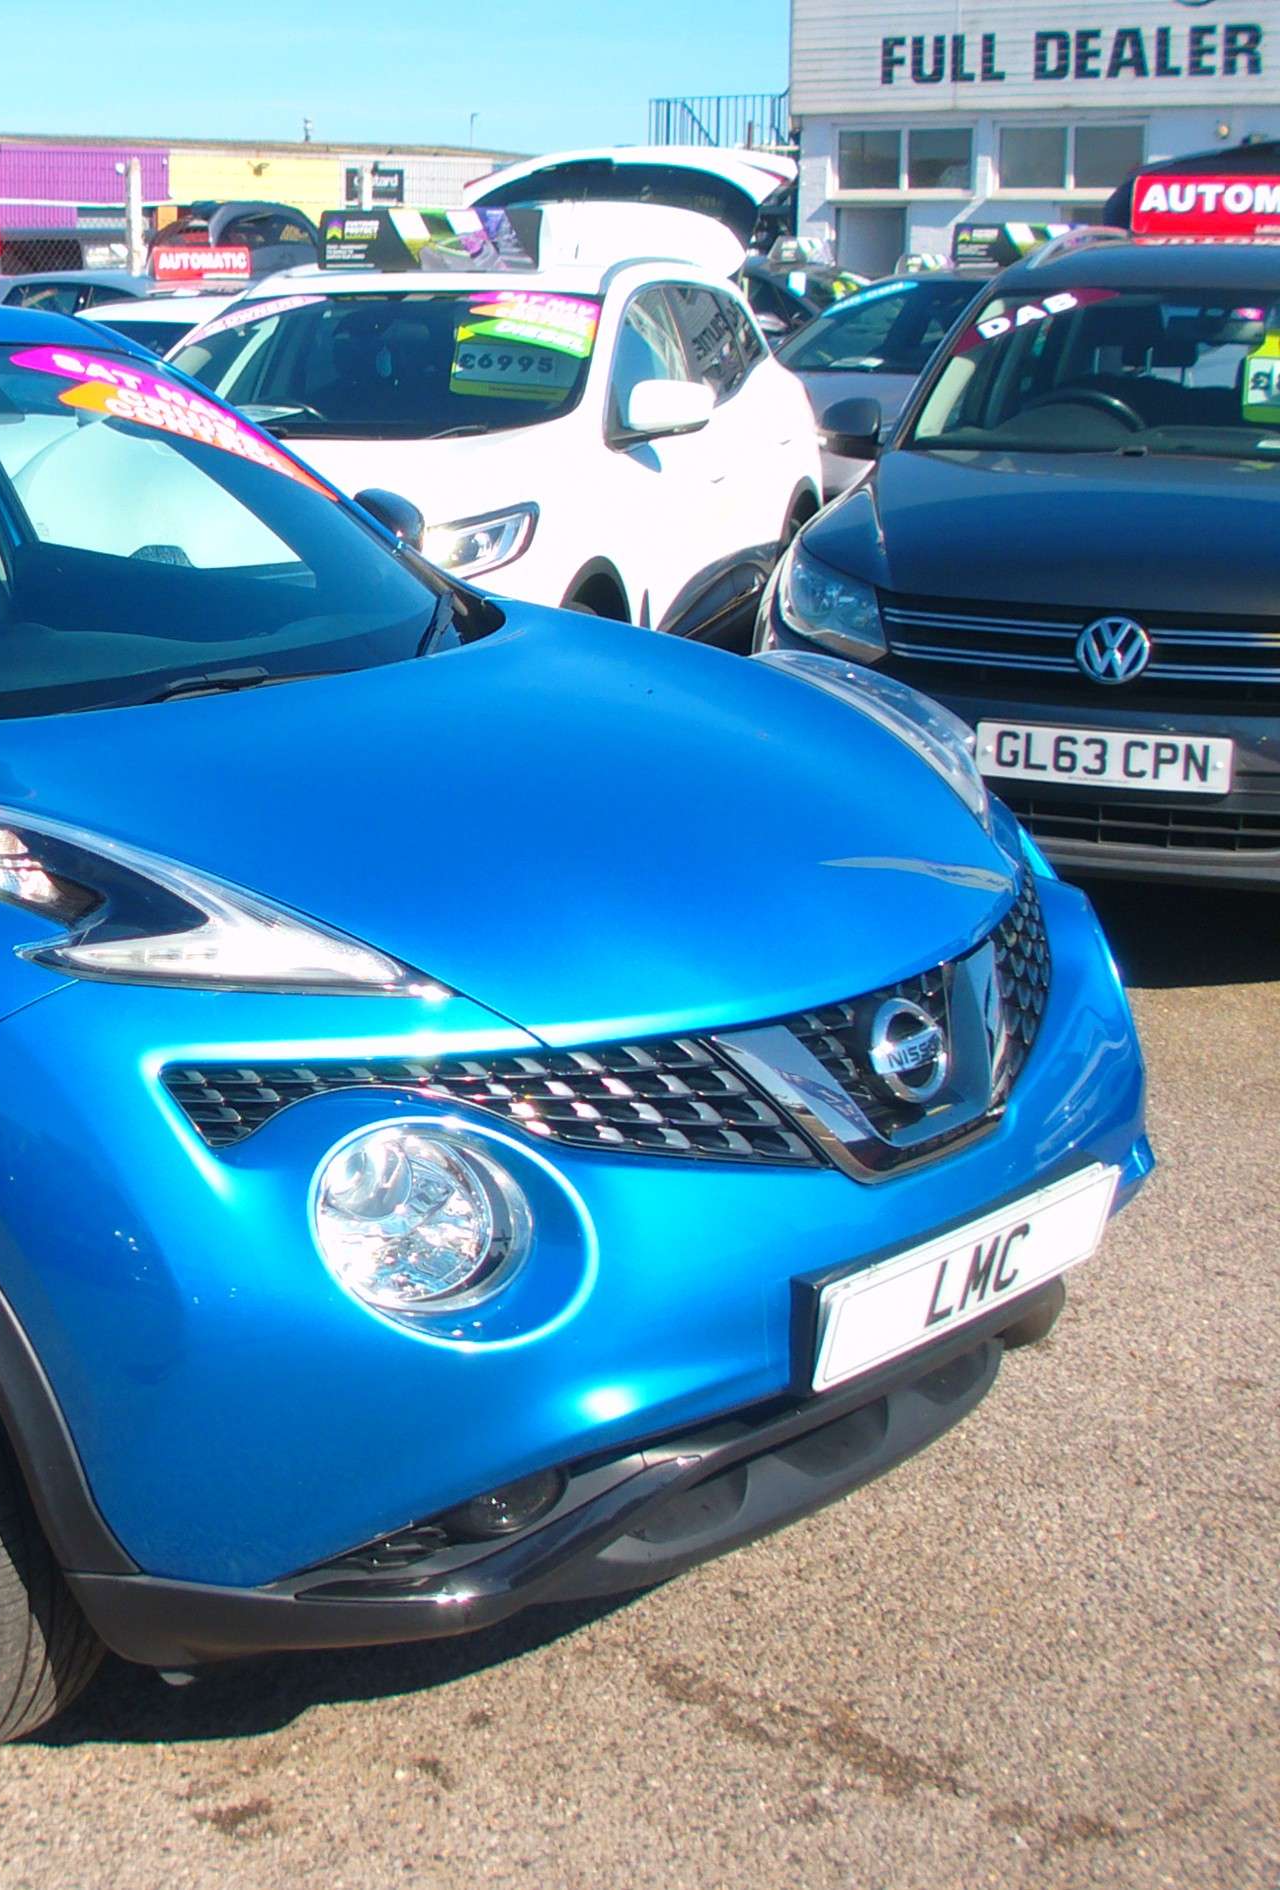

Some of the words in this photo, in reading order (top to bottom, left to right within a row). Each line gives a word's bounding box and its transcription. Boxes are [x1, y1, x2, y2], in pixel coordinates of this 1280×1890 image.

[880, 33, 1006, 85] FULL
[1032, 23, 1264, 81] DEALER
[158, 252, 248, 270] AUTOMATIC
[977, 293, 1078, 339] DAB
[52, 354, 141, 388] SAT
[458, 352, 554, 374] £6995
[996, 731, 1108, 775] GL63
[1122, 741, 1210, 782] CPN
[925, 1223, 1031, 1327] LMC
